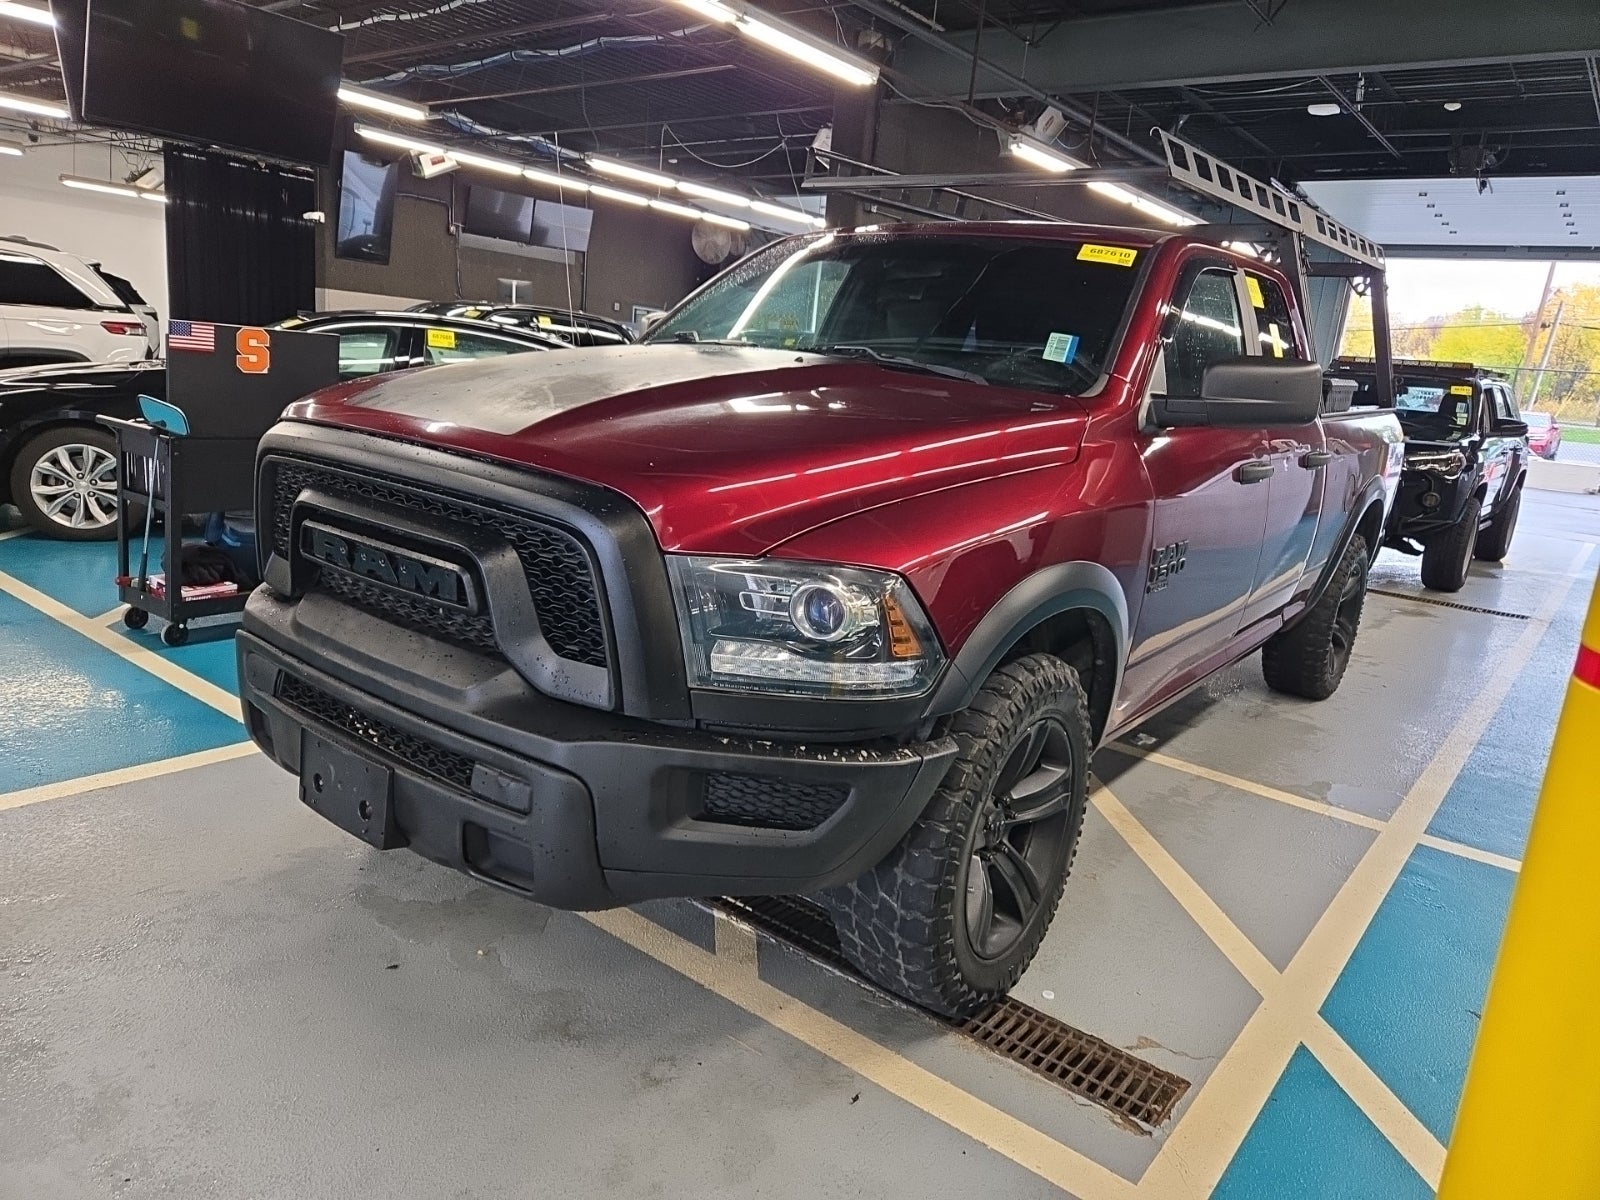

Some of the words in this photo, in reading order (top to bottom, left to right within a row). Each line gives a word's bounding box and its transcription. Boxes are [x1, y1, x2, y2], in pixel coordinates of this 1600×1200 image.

[1089, 248, 1131, 258] 687610
[236, 327, 270, 373] S
[312, 528, 458, 602] RAM
[1151, 540, 1189, 565] RAM
[1148, 557, 1187, 583] 1500
